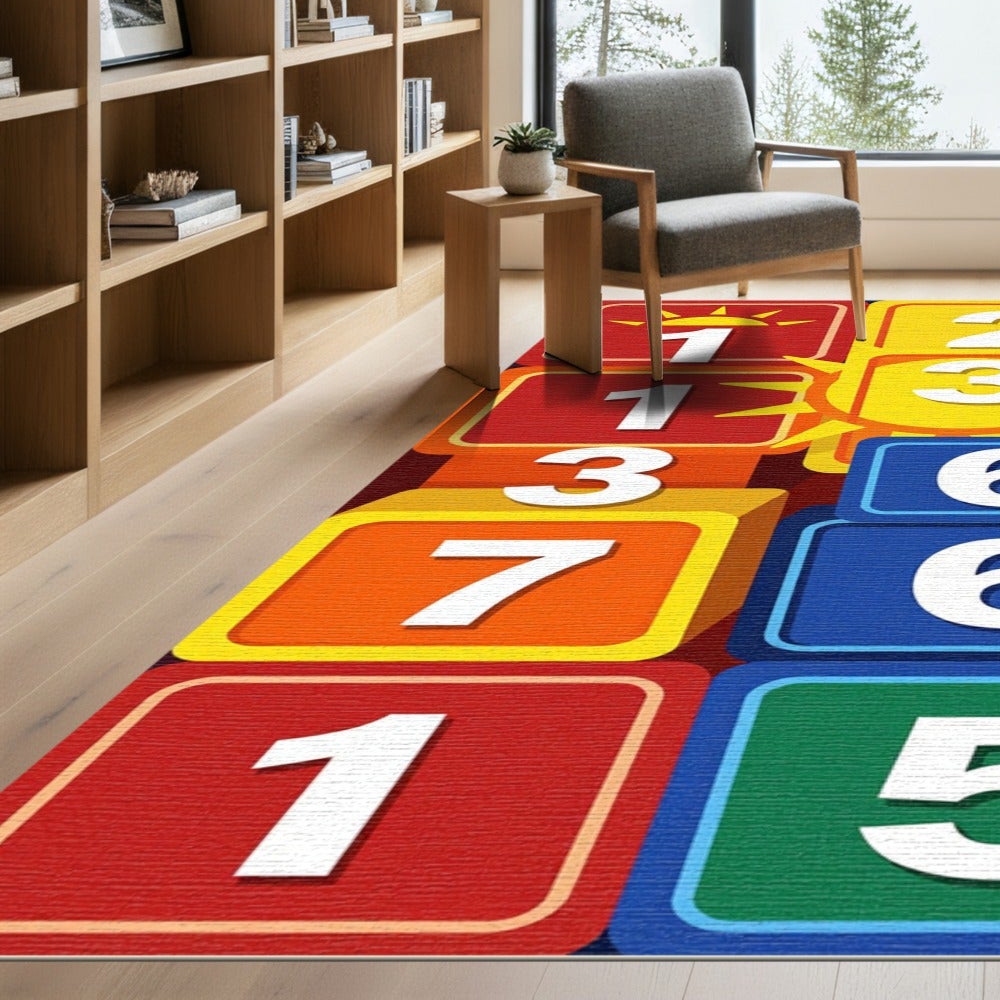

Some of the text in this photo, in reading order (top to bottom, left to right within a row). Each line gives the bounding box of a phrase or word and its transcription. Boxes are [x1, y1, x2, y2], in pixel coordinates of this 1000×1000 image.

[661, 328, 733, 363] 1
[604, 384, 693, 430] 1
[503, 447, 673, 507] 3
[402, 539, 616, 627] 7
[236, 713, 445, 878] 1
